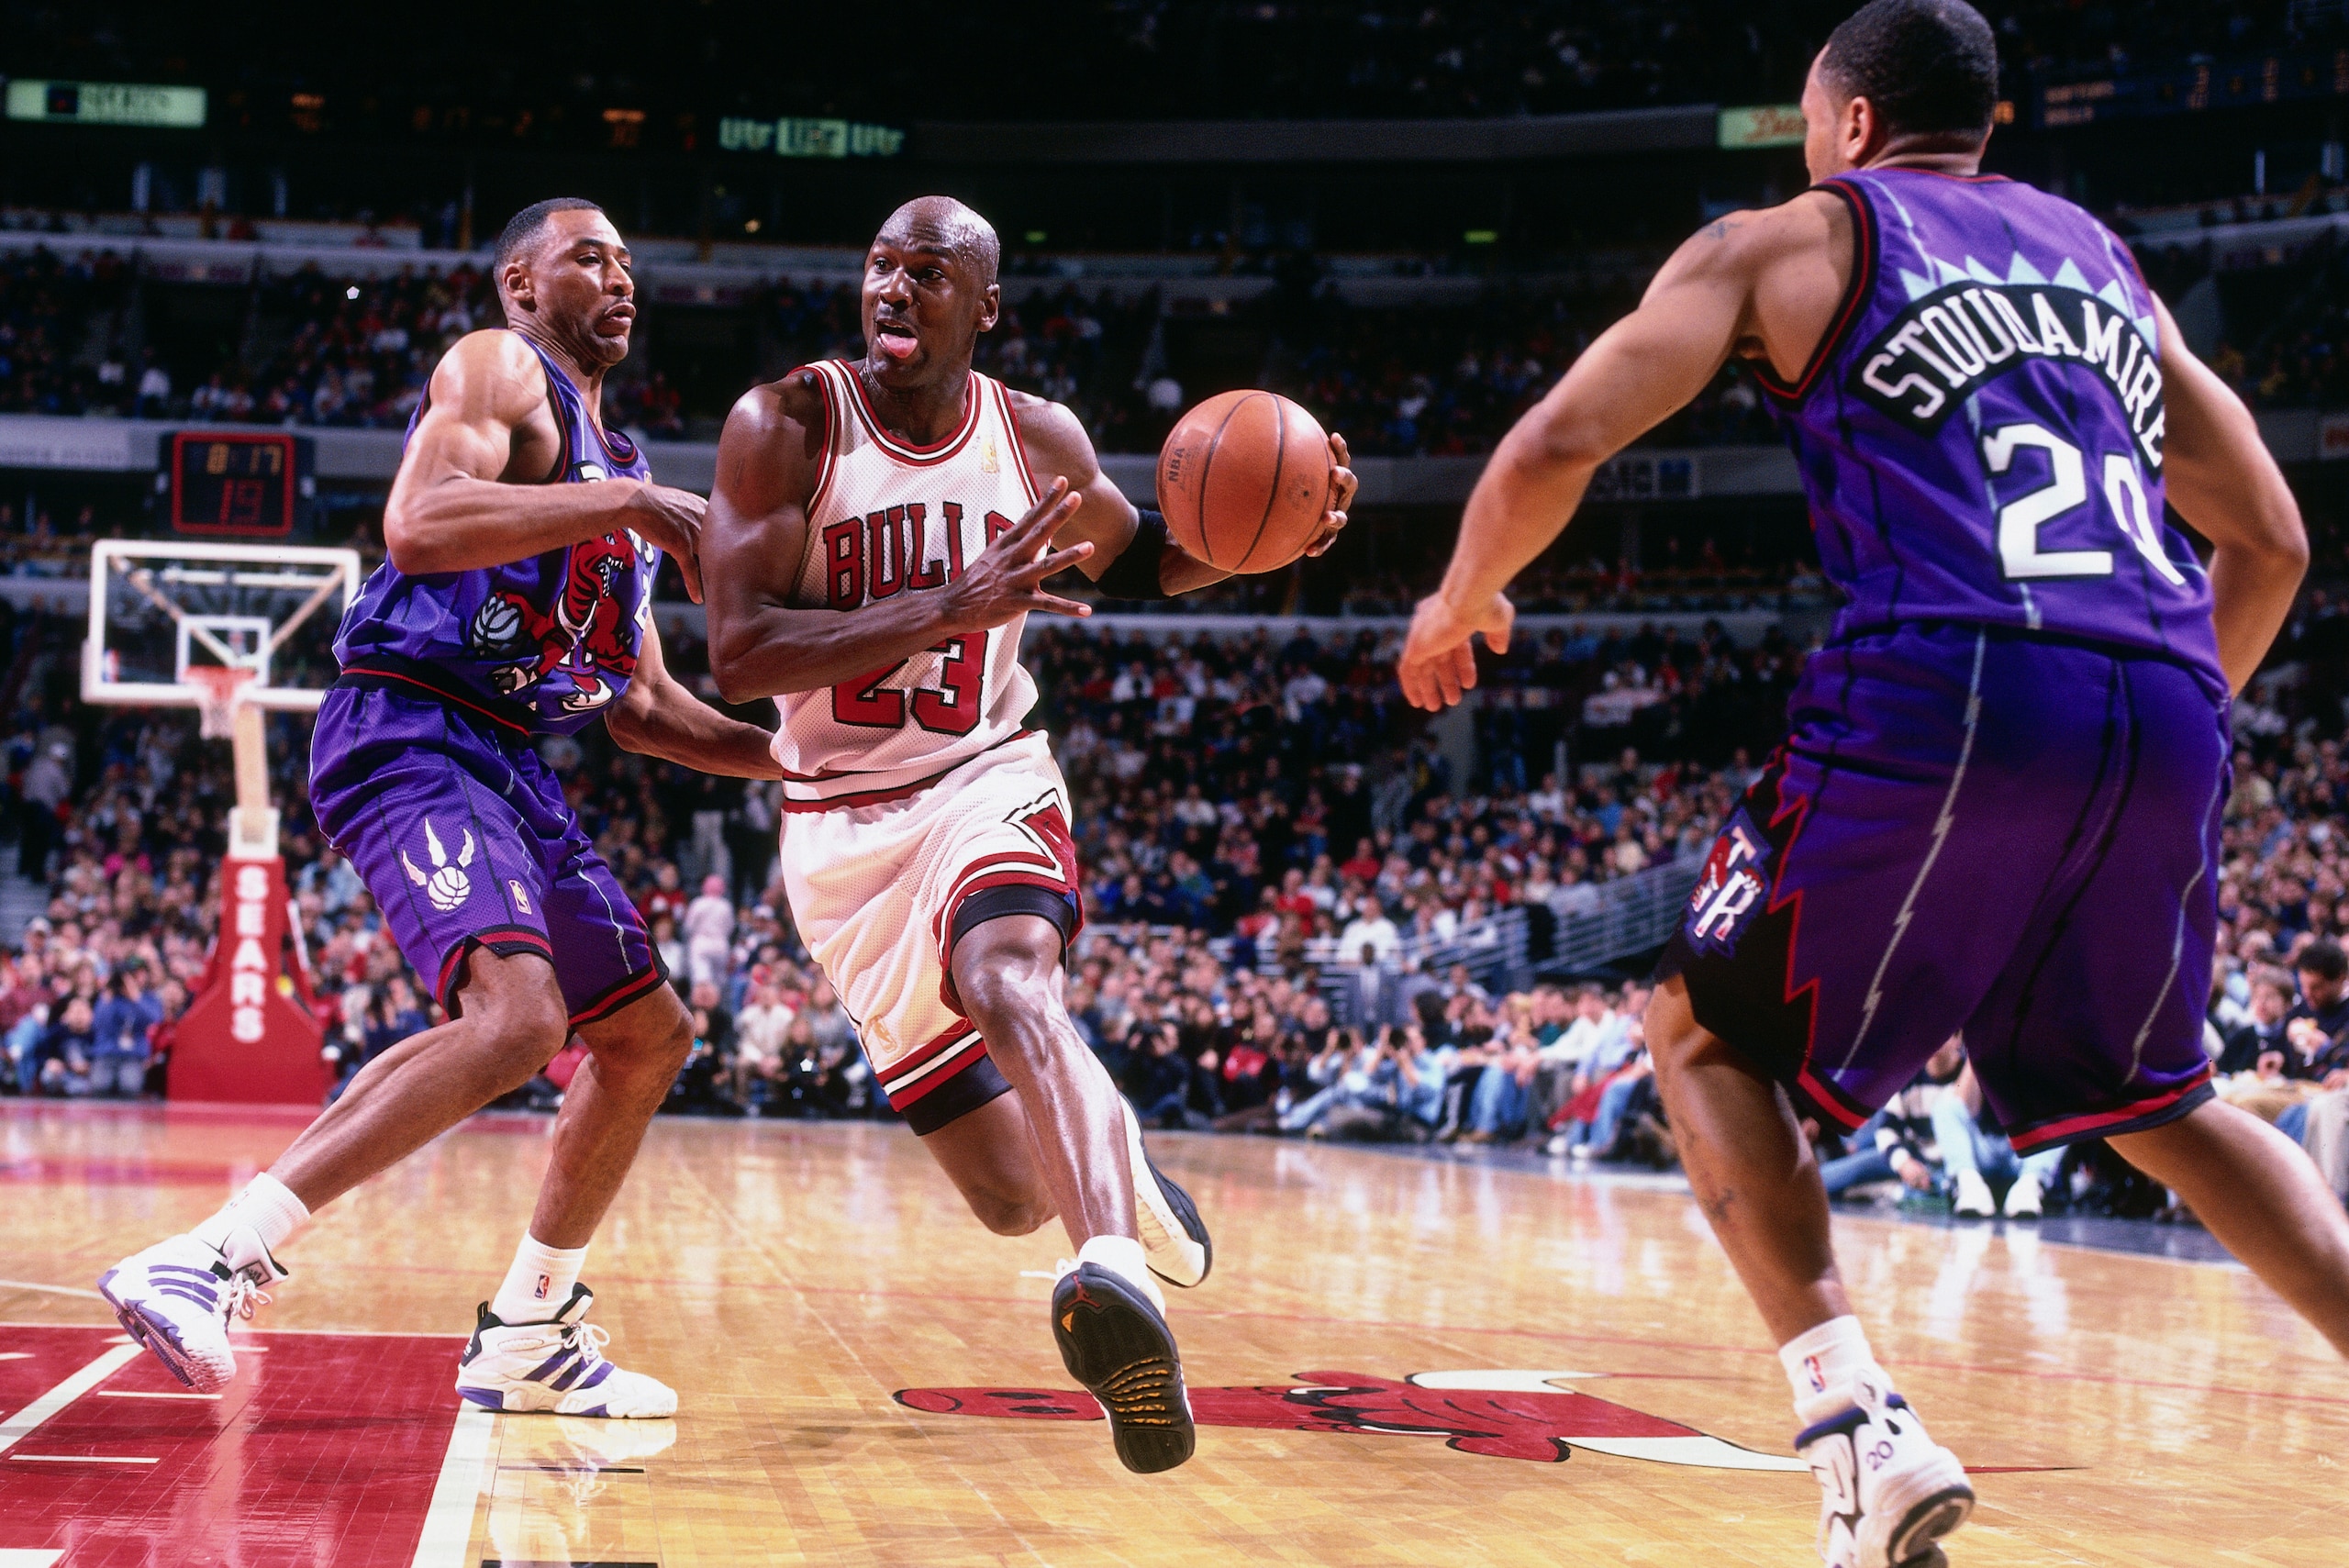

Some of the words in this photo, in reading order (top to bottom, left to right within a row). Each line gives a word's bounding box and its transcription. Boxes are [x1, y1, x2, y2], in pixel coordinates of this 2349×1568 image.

[1168, 448, 1185, 482] NBA
[1984, 423, 2186, 585] 20
[823, 501, 1016, 611] BULL
[831, 629, 989, 736] 23
[231, 864, 269, 1043] SEARS
[1866, 1440, 1894, 1471] 20
